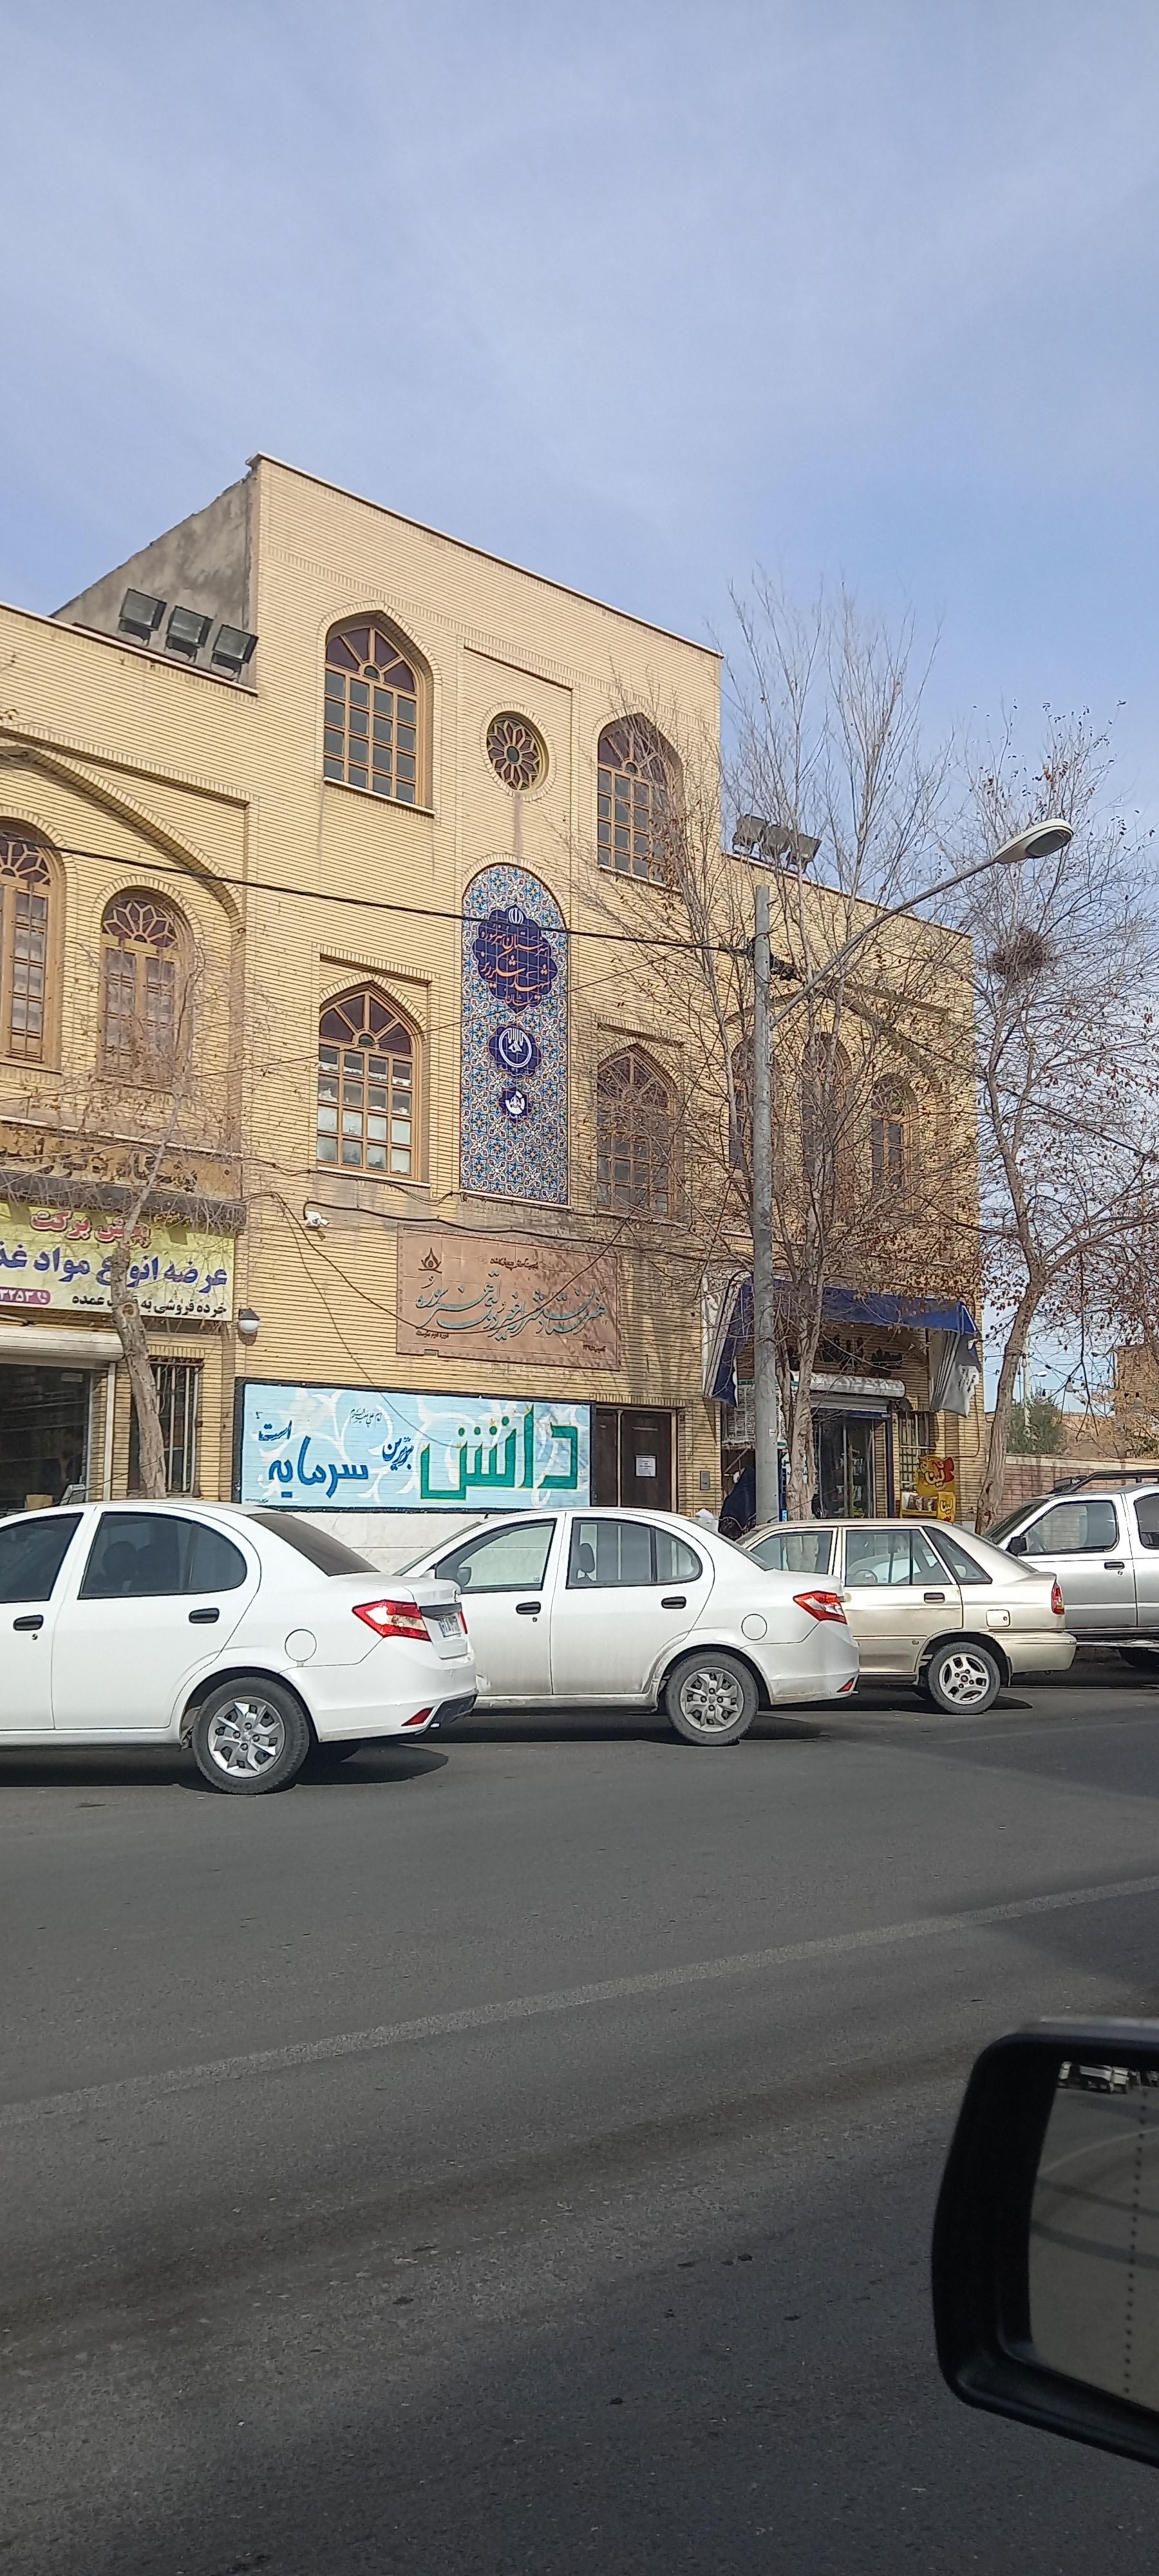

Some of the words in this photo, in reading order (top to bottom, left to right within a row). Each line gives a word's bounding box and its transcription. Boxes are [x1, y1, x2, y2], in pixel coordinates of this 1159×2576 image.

[31, 1209, 91, 1240] برکت
[34, 1247, 90, 1282] مواد
[96, 1255, 159, 1289] انوع
[164, 1260, 228, 1294] عرضه
[72, 1294, 105, 1306] عمده
[140, 1300, 152, 1313] به
[154, 1296, 194, 1316] فروشی
[196, 1302, 227, 1319] خرده
[258, 1419, 293, 1441] است
[268, 1435, 369, 1499] سرمایه
[382, 1436, 415, 1471] برترین
[420, 1403, 578, 1500] دانش
